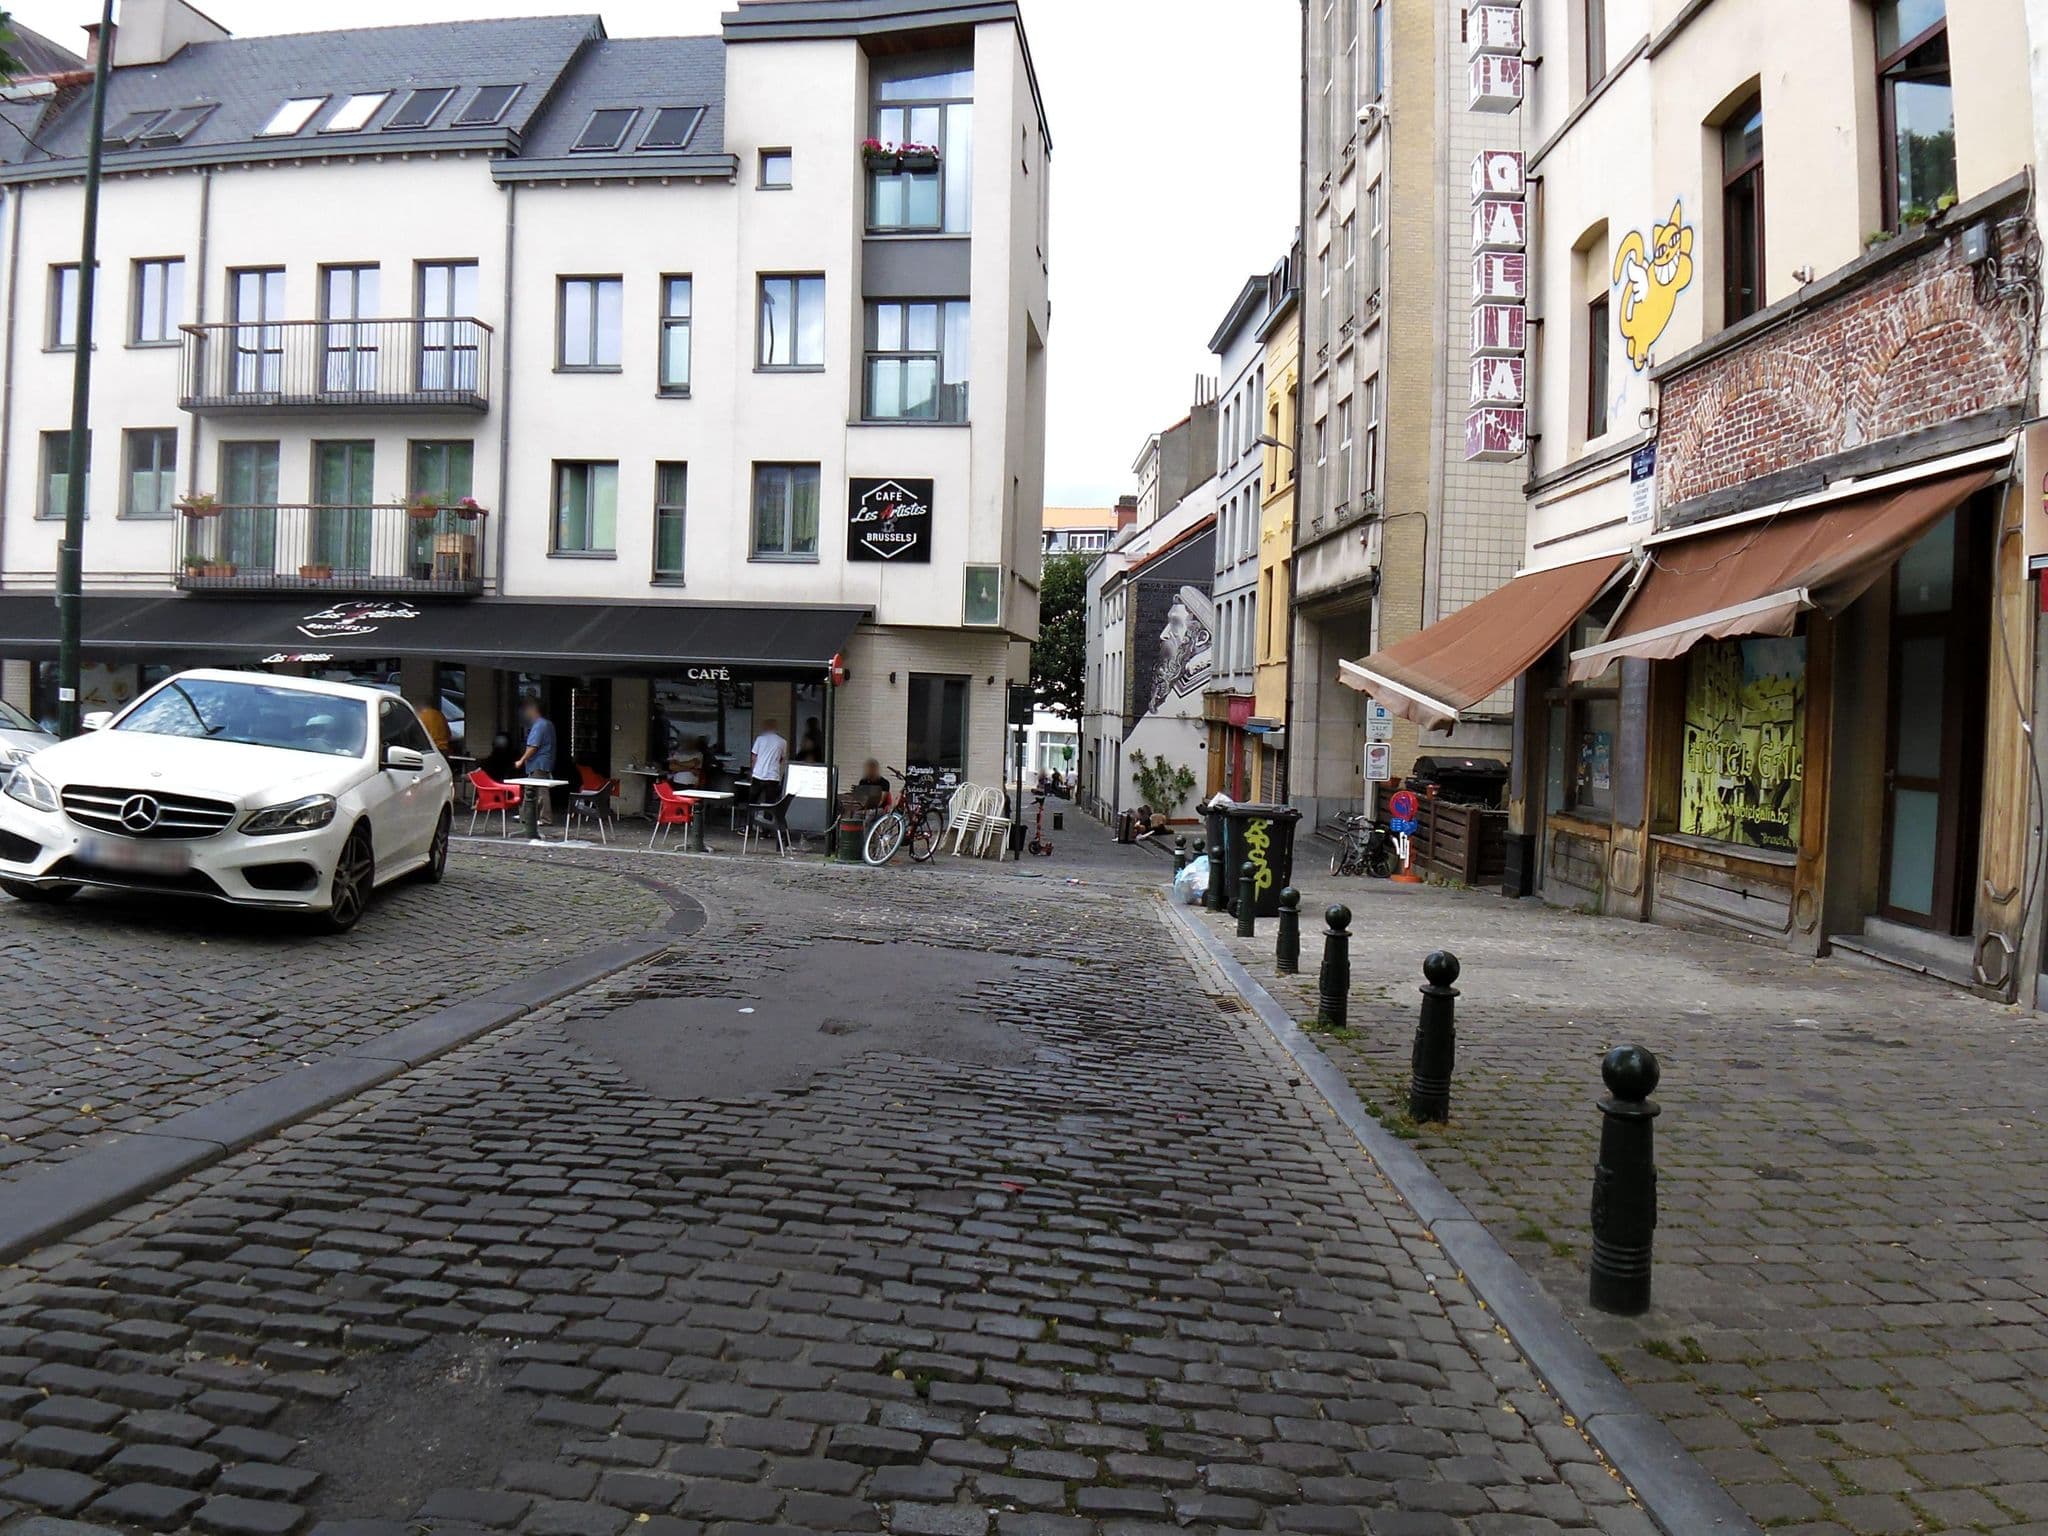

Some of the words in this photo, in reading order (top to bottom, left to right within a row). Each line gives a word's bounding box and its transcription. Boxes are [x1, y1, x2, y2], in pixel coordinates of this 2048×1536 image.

[1488, 154, 1521, 399] GALIA
[875, 489, 903, 501] CAFÉ
[850, 506, 879, 523] Les
[880, 502, 927, 519] Artistes
[866, 532, 912, 542] BRUSSELS
[687, 666, 730, 681] CAFÉ
